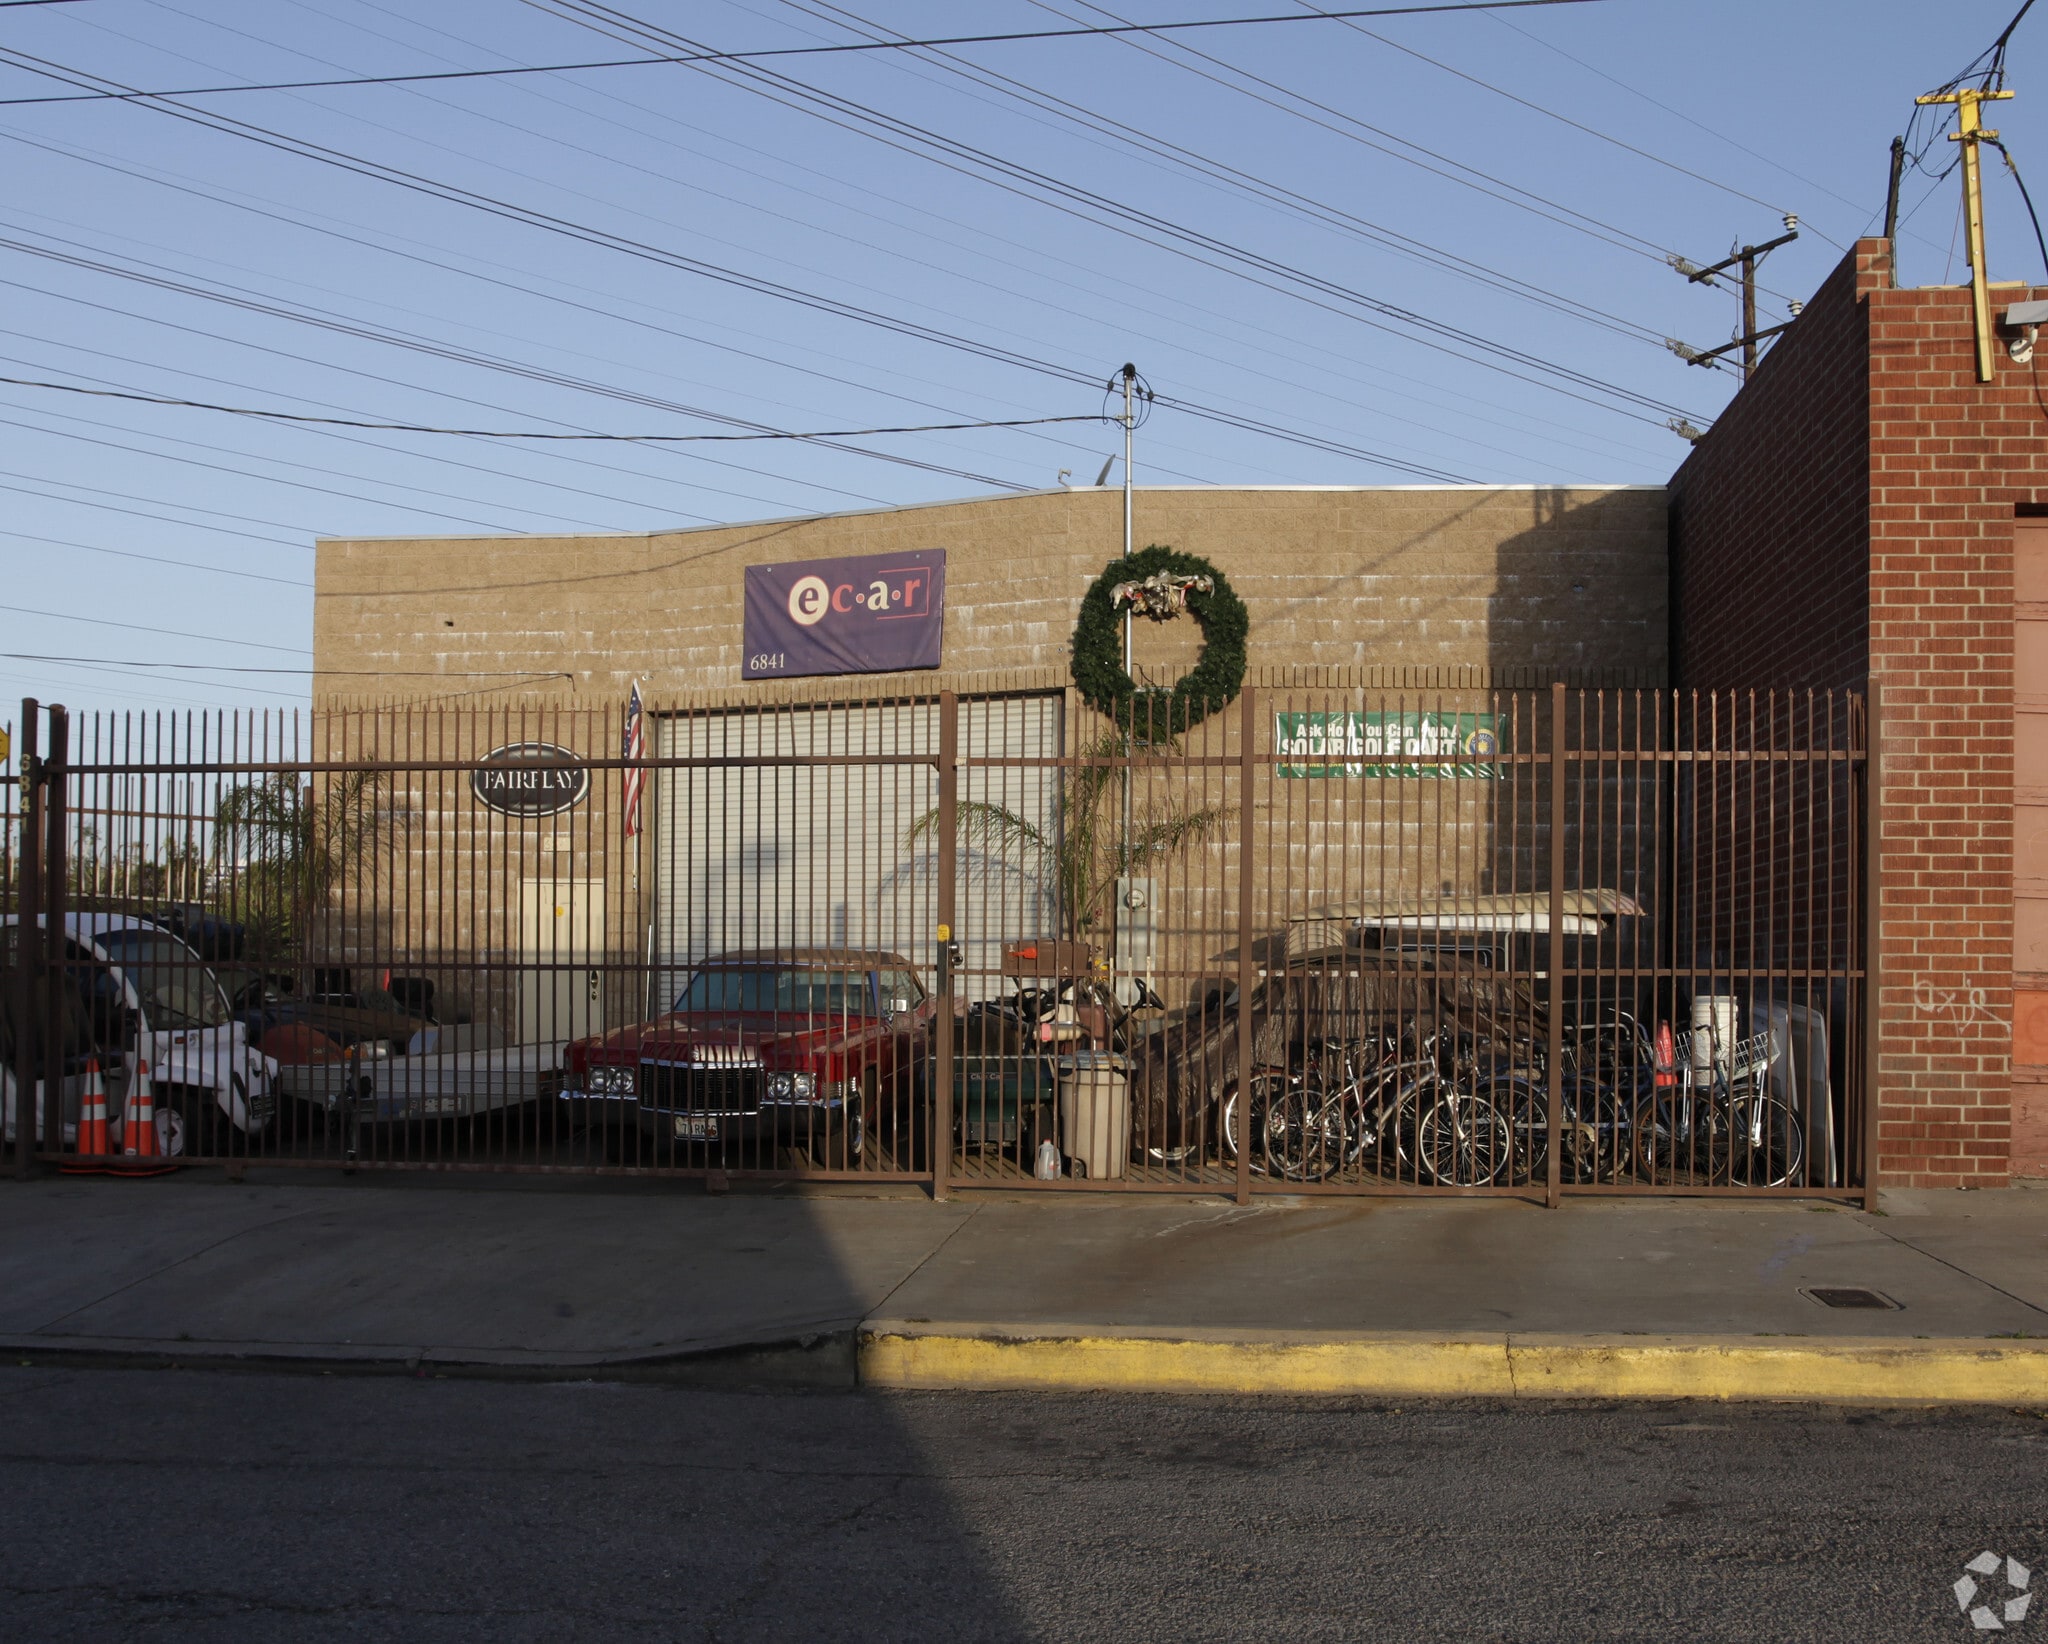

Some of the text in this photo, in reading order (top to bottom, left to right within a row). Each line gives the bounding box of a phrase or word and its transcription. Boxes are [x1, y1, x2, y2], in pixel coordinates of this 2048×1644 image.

[750, 653, 785, 671] 6841
[1296, 723, 1323, 737] Ask
[1359, 723, 1382, 737] You
[1387, 723, 1414, 737] Can
[1281, 738, 1344, 756] SOLAR
[1355, 738, 1401, 756] GOLF
[19, 753, 31, 834] 6841
[970, 1072, 1003, 1081] Clu Ca
